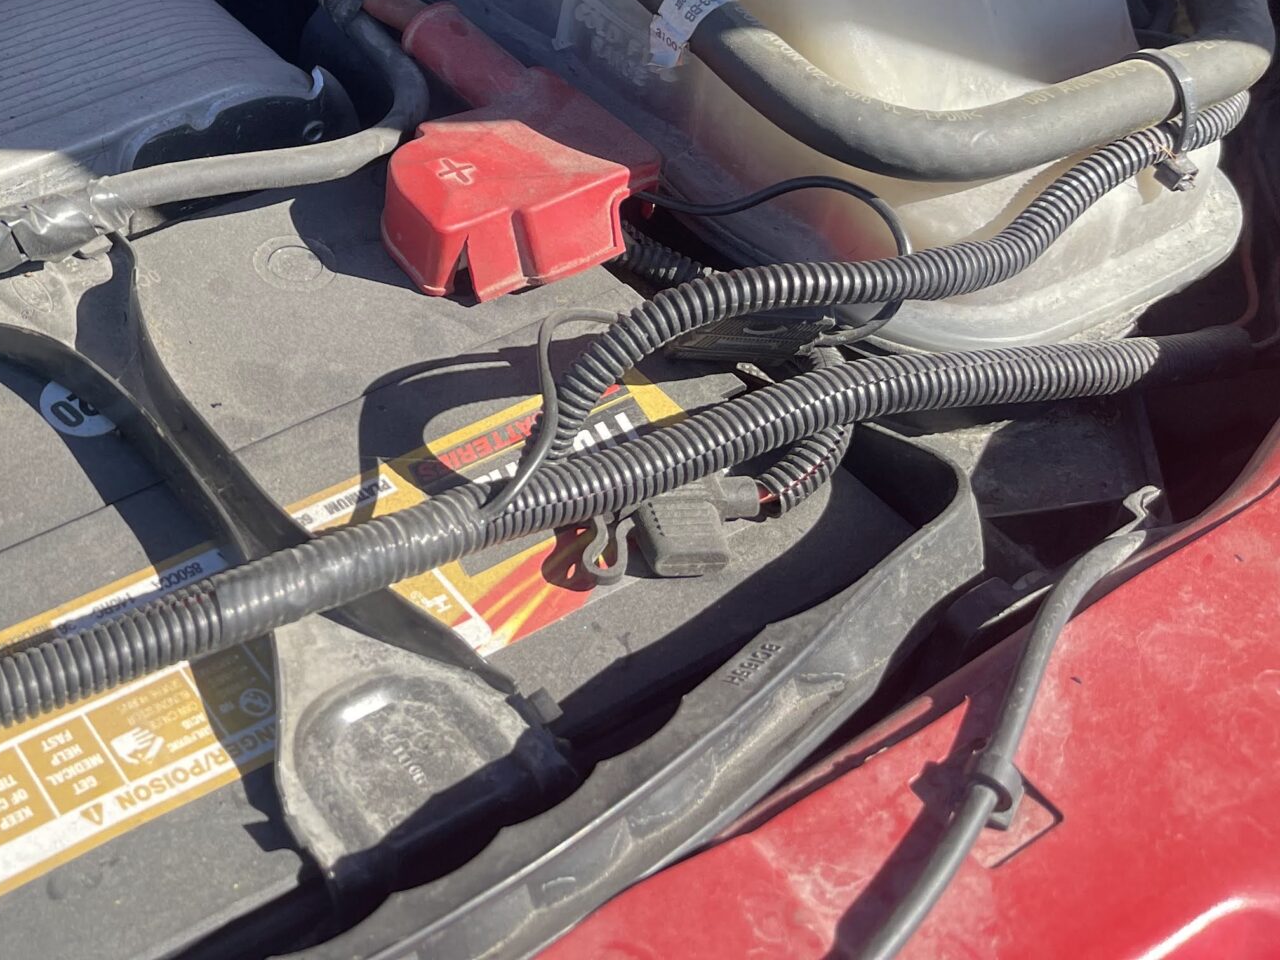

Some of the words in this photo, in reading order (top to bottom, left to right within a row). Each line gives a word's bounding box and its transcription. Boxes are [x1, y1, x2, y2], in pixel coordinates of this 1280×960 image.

[322, 477, 392, 516] PLATINUM
[37, 726, 74, 753] FAST
[47, 740, 83, 768] HELP
[43, 751, 104, 788] MEDICAL
[6, 786, 29, 806] OF
[69, 772, 99, 796] GET
